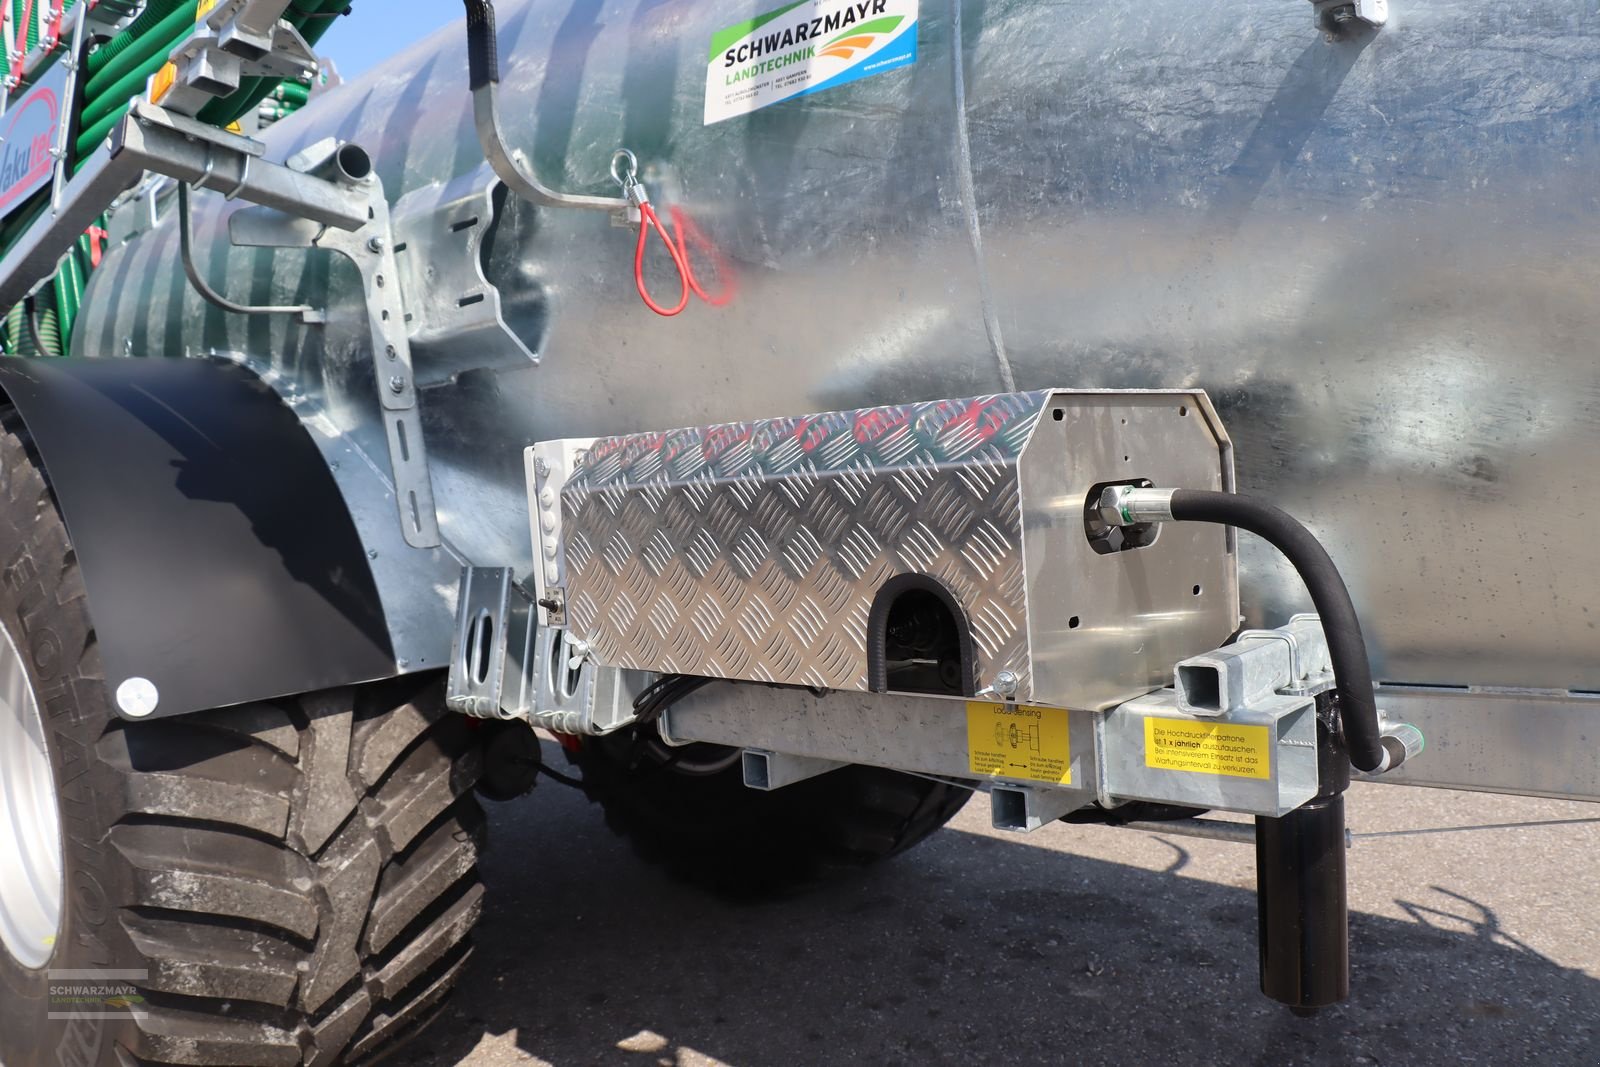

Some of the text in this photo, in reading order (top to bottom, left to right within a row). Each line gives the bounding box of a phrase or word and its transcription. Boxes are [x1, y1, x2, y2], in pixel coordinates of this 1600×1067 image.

[724, 0, 886, 68] SCHWARZMAYR
[725, 45, 816, 86] LANDTECHNIK
[1154, 728, 1245, 742] Die Hochdruckfilterpatrone
[1155, 757, 1212, 769] Wartungsintervall
[1166, 749, 1209, 760] intensiverem
[1210, 752, 1234, 762] Einsatz
[1235, 754, 1243, 763] ist
[1245, 756, 1258, 764] das
